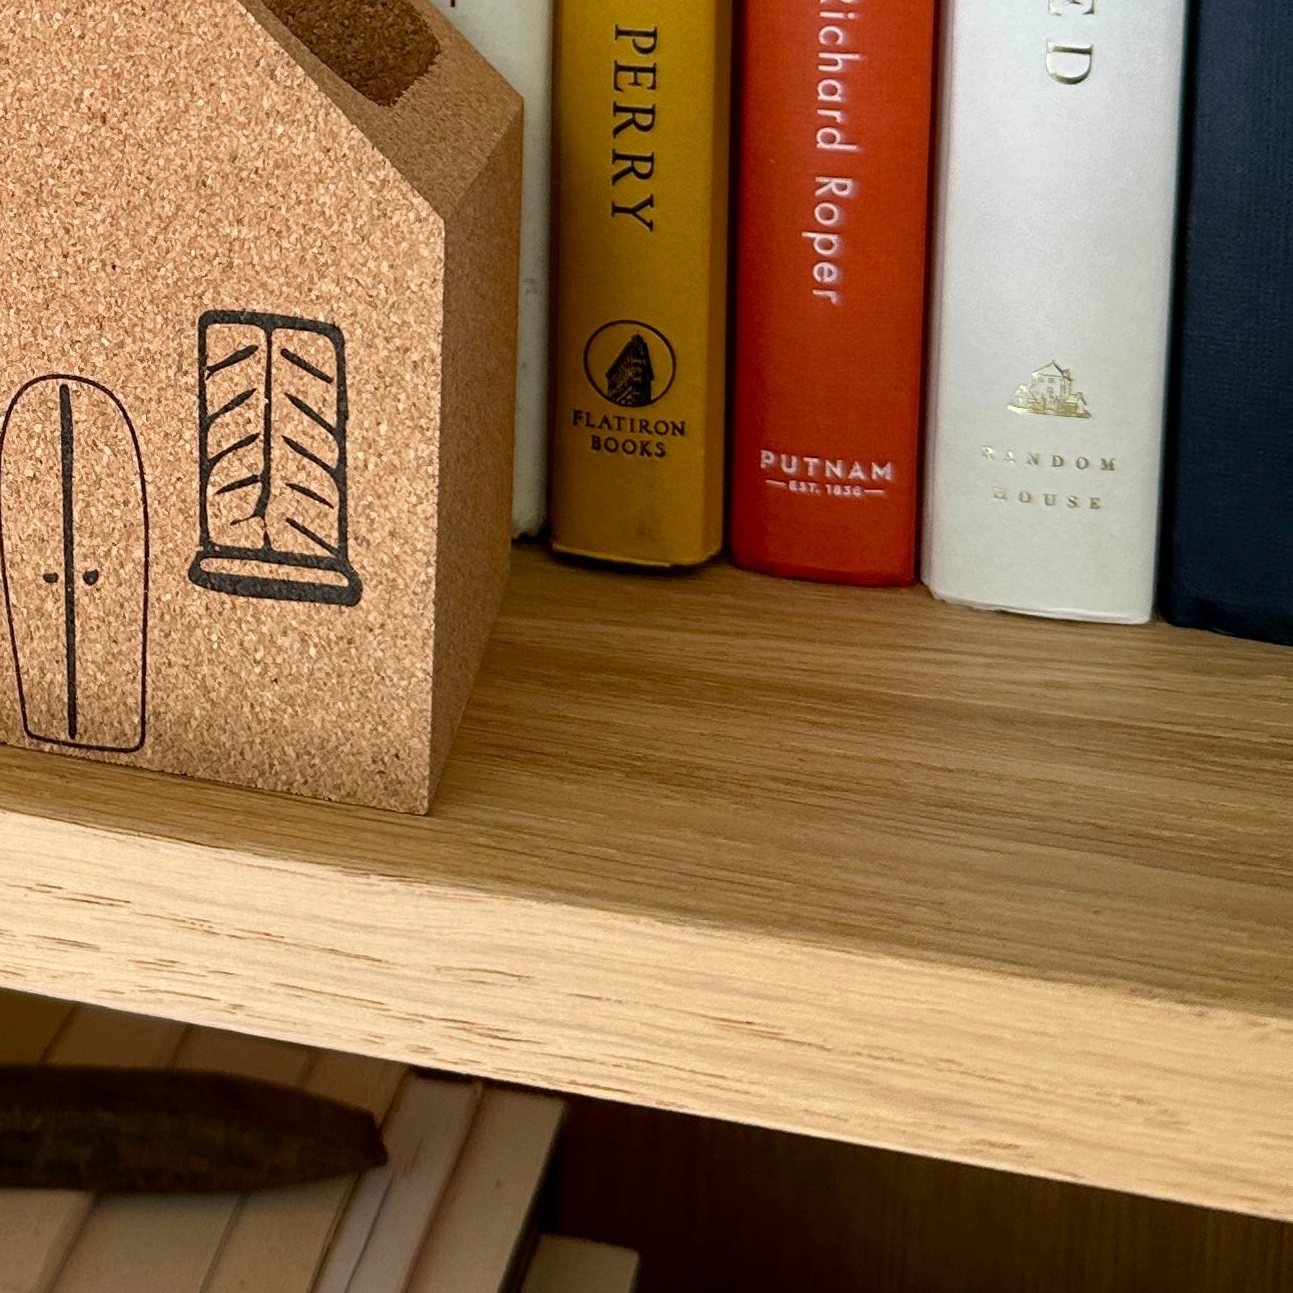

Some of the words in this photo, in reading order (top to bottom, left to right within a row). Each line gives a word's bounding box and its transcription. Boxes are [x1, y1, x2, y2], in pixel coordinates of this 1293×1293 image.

[610, 24, 659, 233] PERRY
[802, 175, 853, 305] Roper
[572, 409, 686, 437] FLATIRON
[590, 434, 667, 459] BOOKS
[760, 449, 893, 481] PUTNAM
